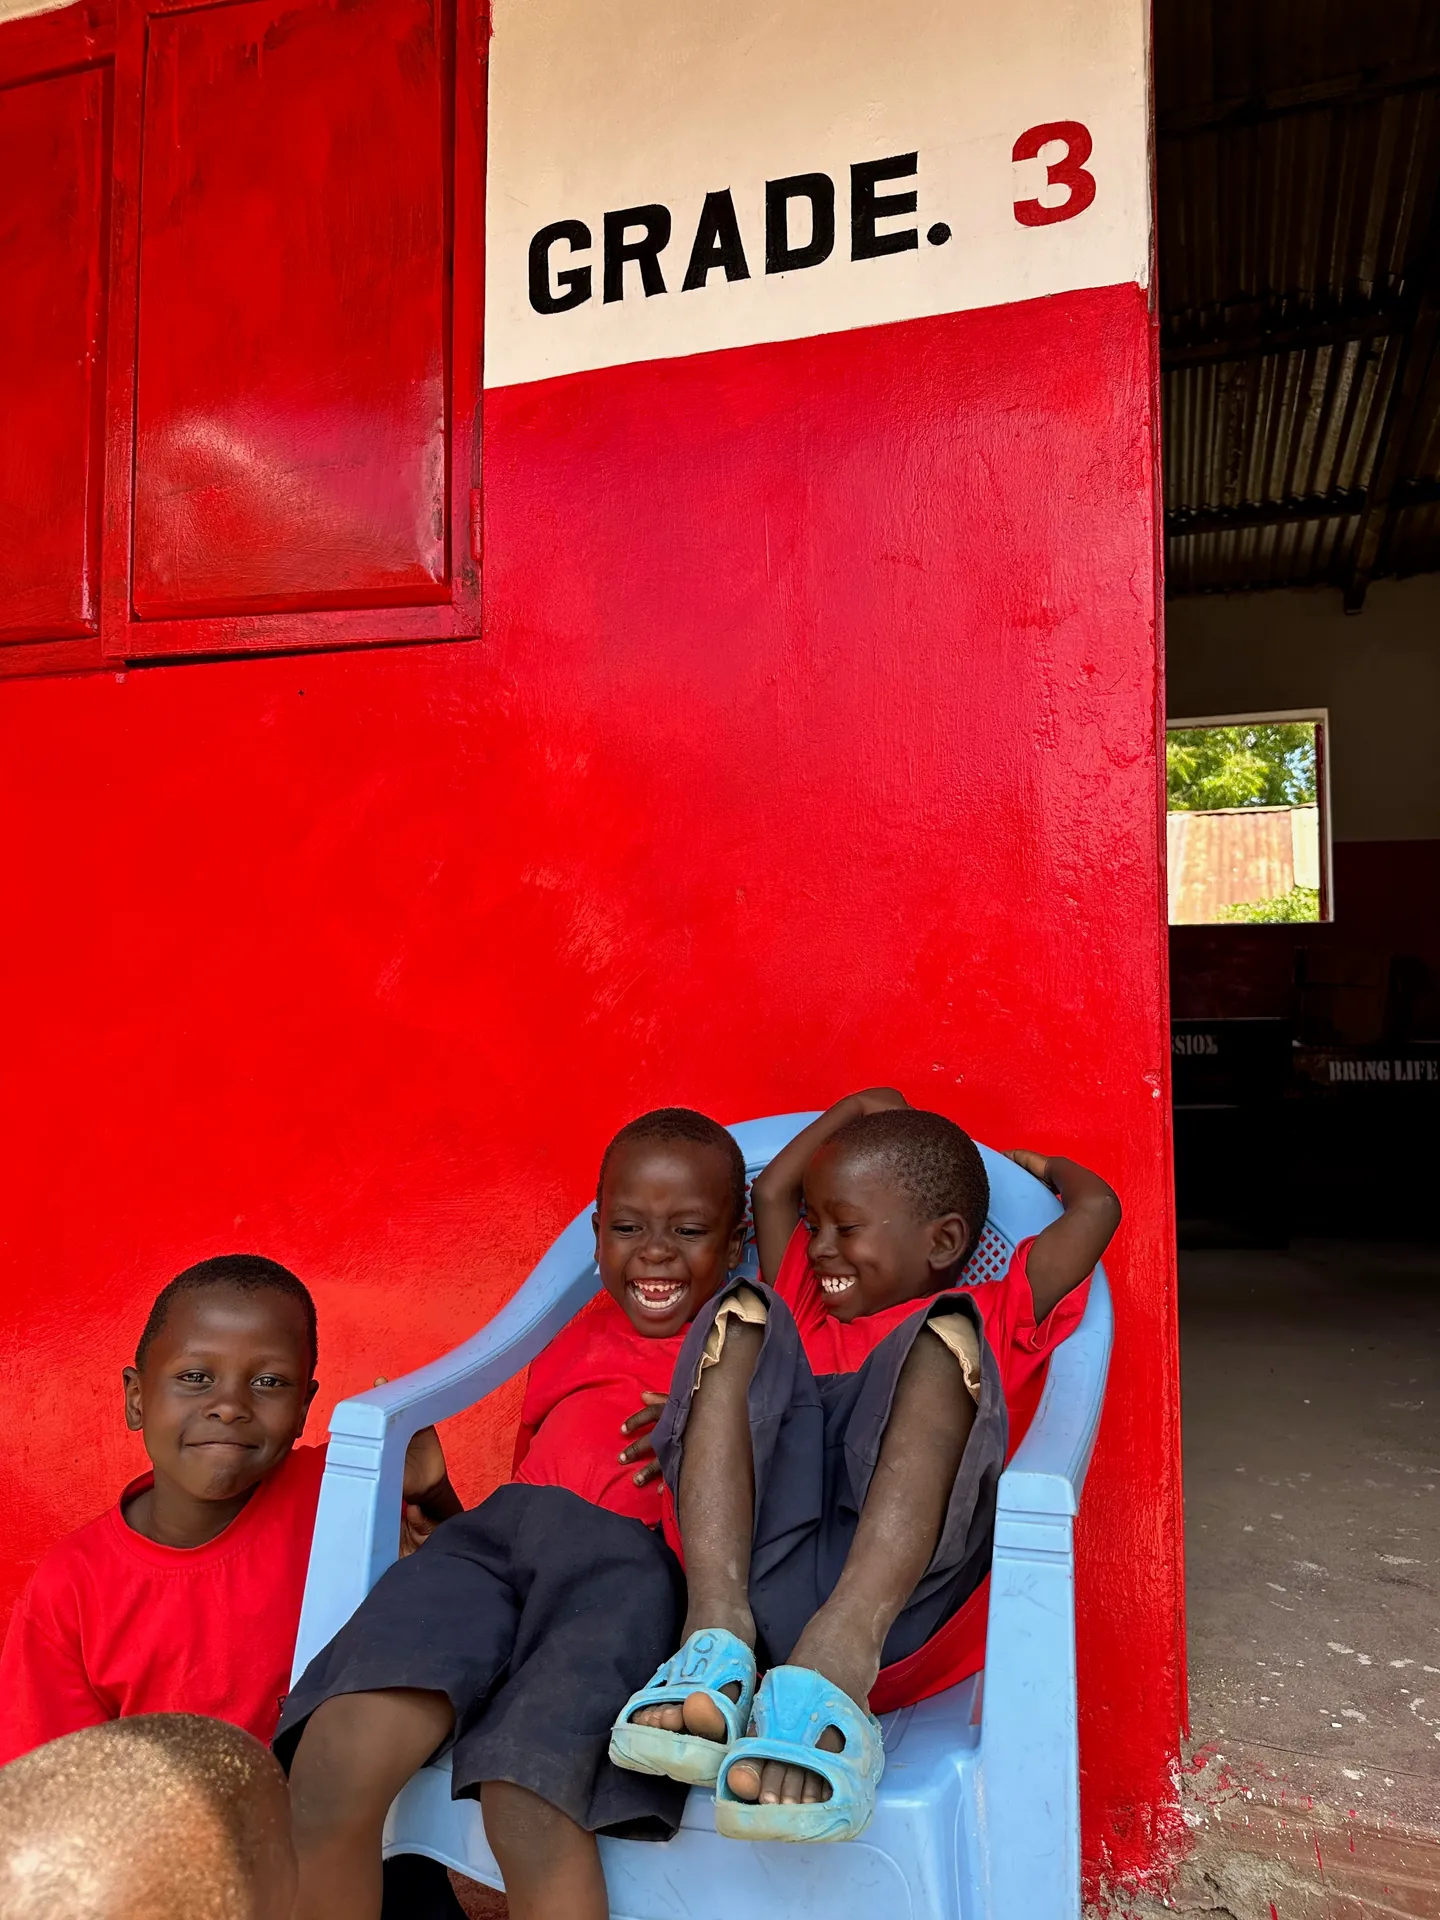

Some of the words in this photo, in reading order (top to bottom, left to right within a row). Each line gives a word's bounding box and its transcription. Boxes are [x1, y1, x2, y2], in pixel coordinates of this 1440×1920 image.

[528, 152, 952, 315] GRADE.
[1011, 120, 1097, 228] 3
[1328, 1060, 1391, 1082] BRING
[1394, 1060, 1439, 1082] LIFE
